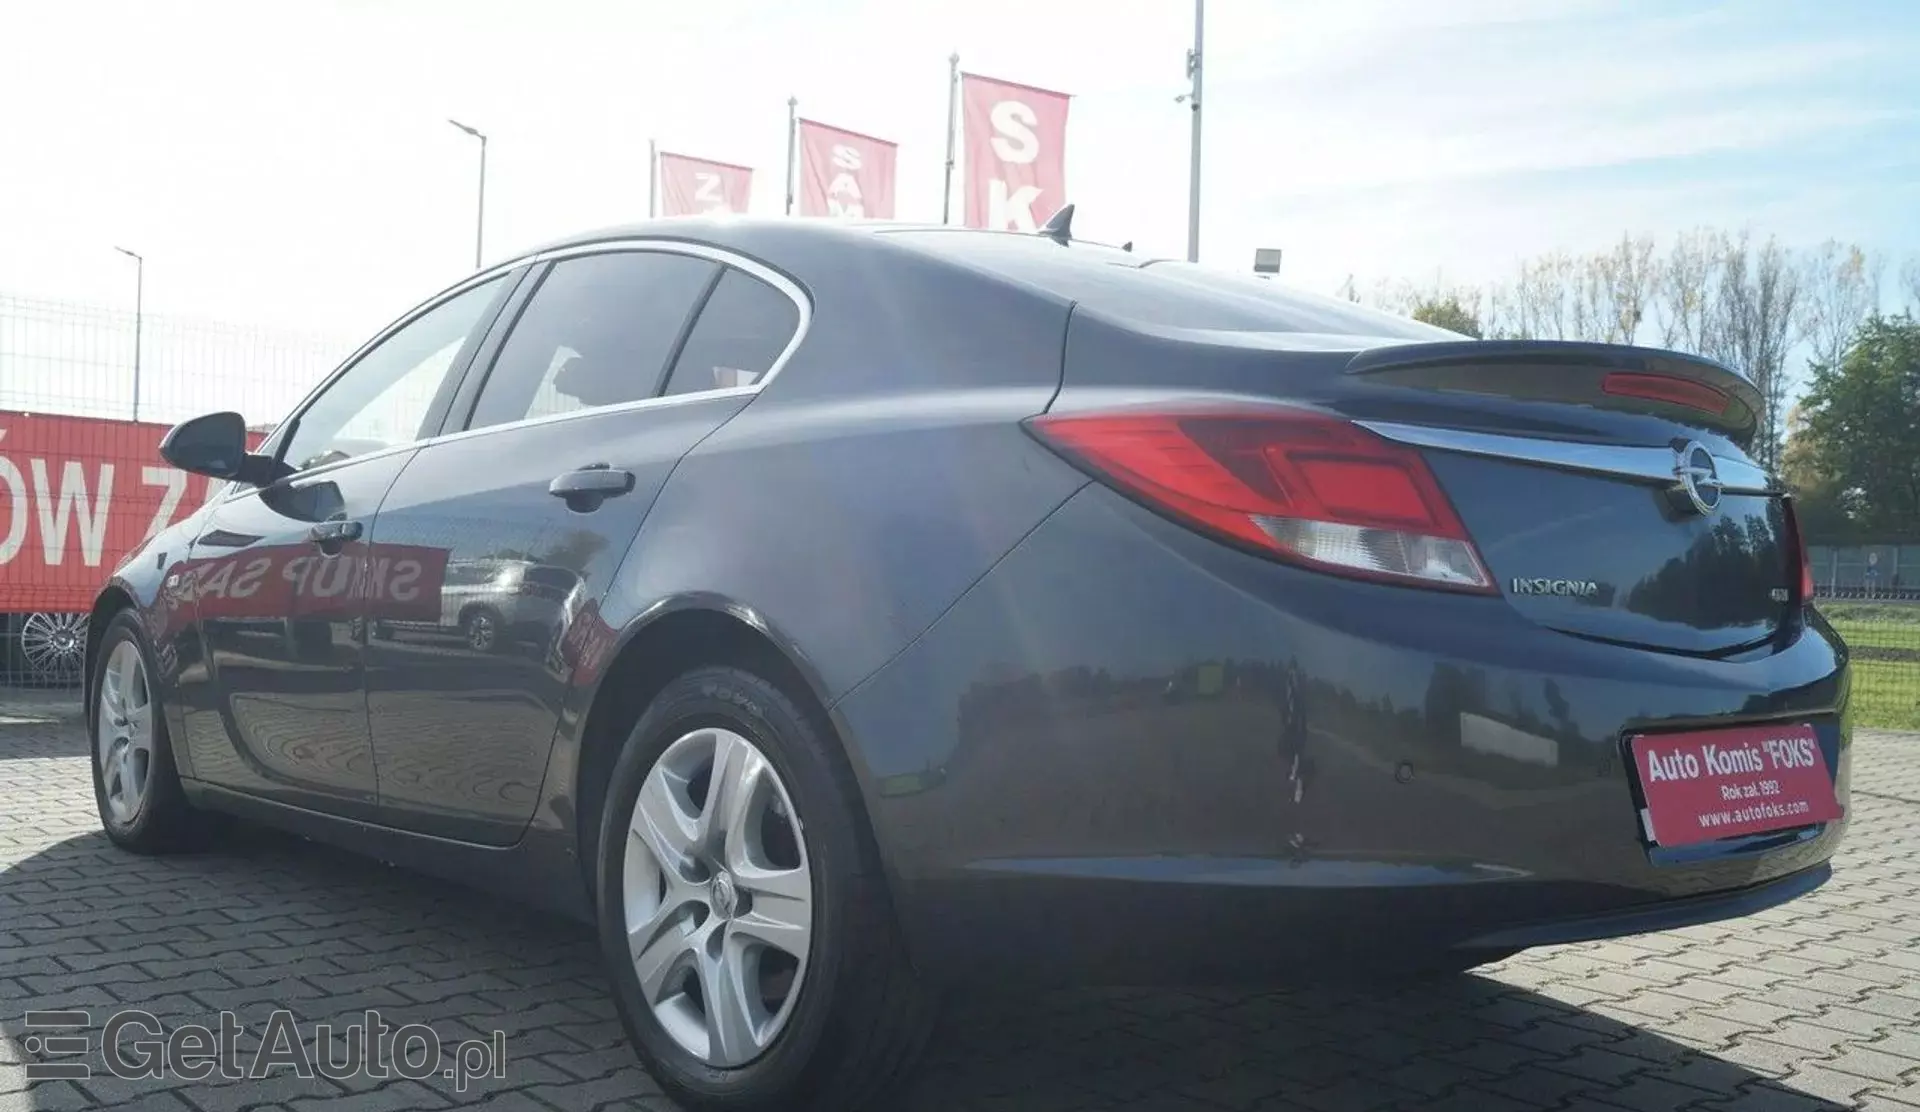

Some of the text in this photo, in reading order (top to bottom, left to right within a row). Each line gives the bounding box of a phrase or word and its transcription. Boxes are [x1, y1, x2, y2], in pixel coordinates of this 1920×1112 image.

[1512, 577, 1598, 597] INSIGNIA
[1648, 738, 1815, 782] Auto Komis "FOKS"
[1721, 783, 1743, 801] Rok
[1699, 801, 1809, 827] www.autofoks.com
